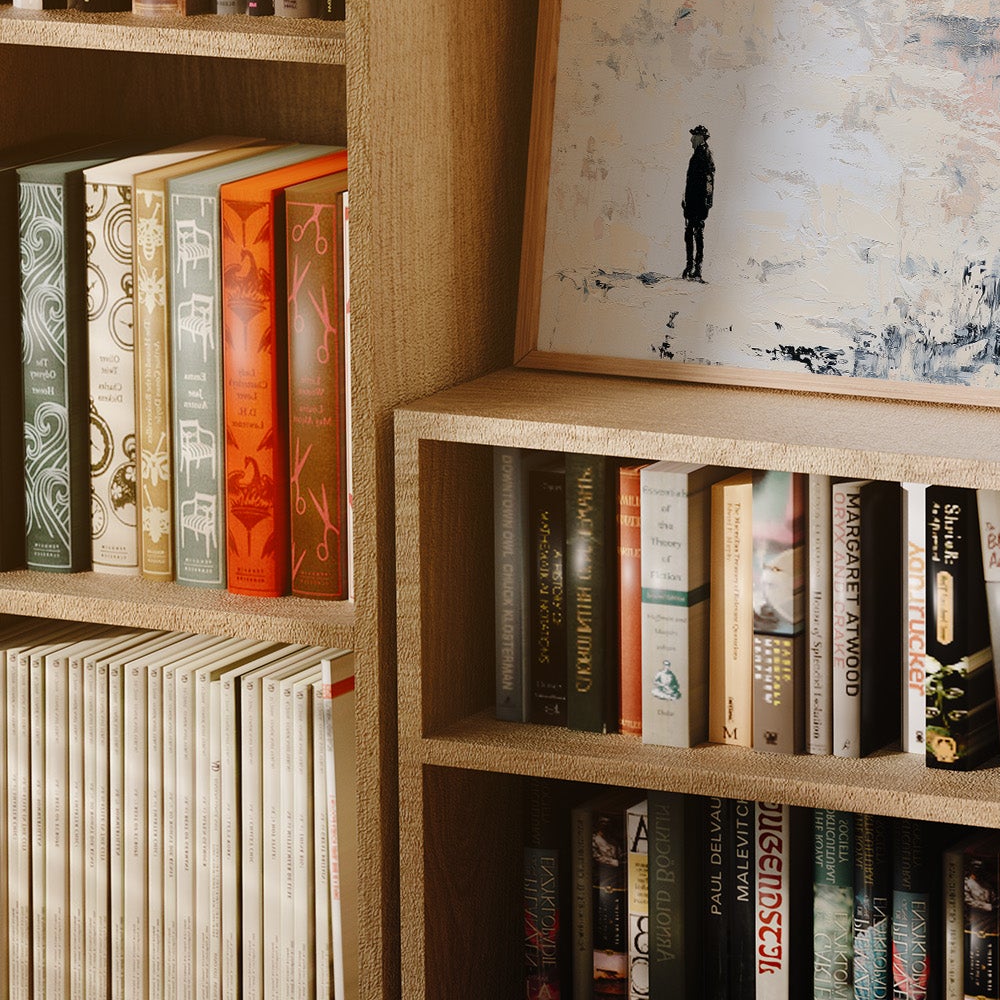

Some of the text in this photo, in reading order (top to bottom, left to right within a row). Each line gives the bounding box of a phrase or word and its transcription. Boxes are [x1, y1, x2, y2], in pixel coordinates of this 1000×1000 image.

[658, 521, 674, 530] the
[651, 537, 682, 549] Theory
[661, 555, 672, 563] of
[650, 570, 682, 582] Fiction
[833, 491, 847, 668] ORYX AND CRAKE
[845, 493, 861, 697] MARGARET ATWOOD
[502, 609, 514, 691] KLOSTERMAN
[722, 726, 738, 739] M
[710, 797, 722, 915] PAUL DELVAU
